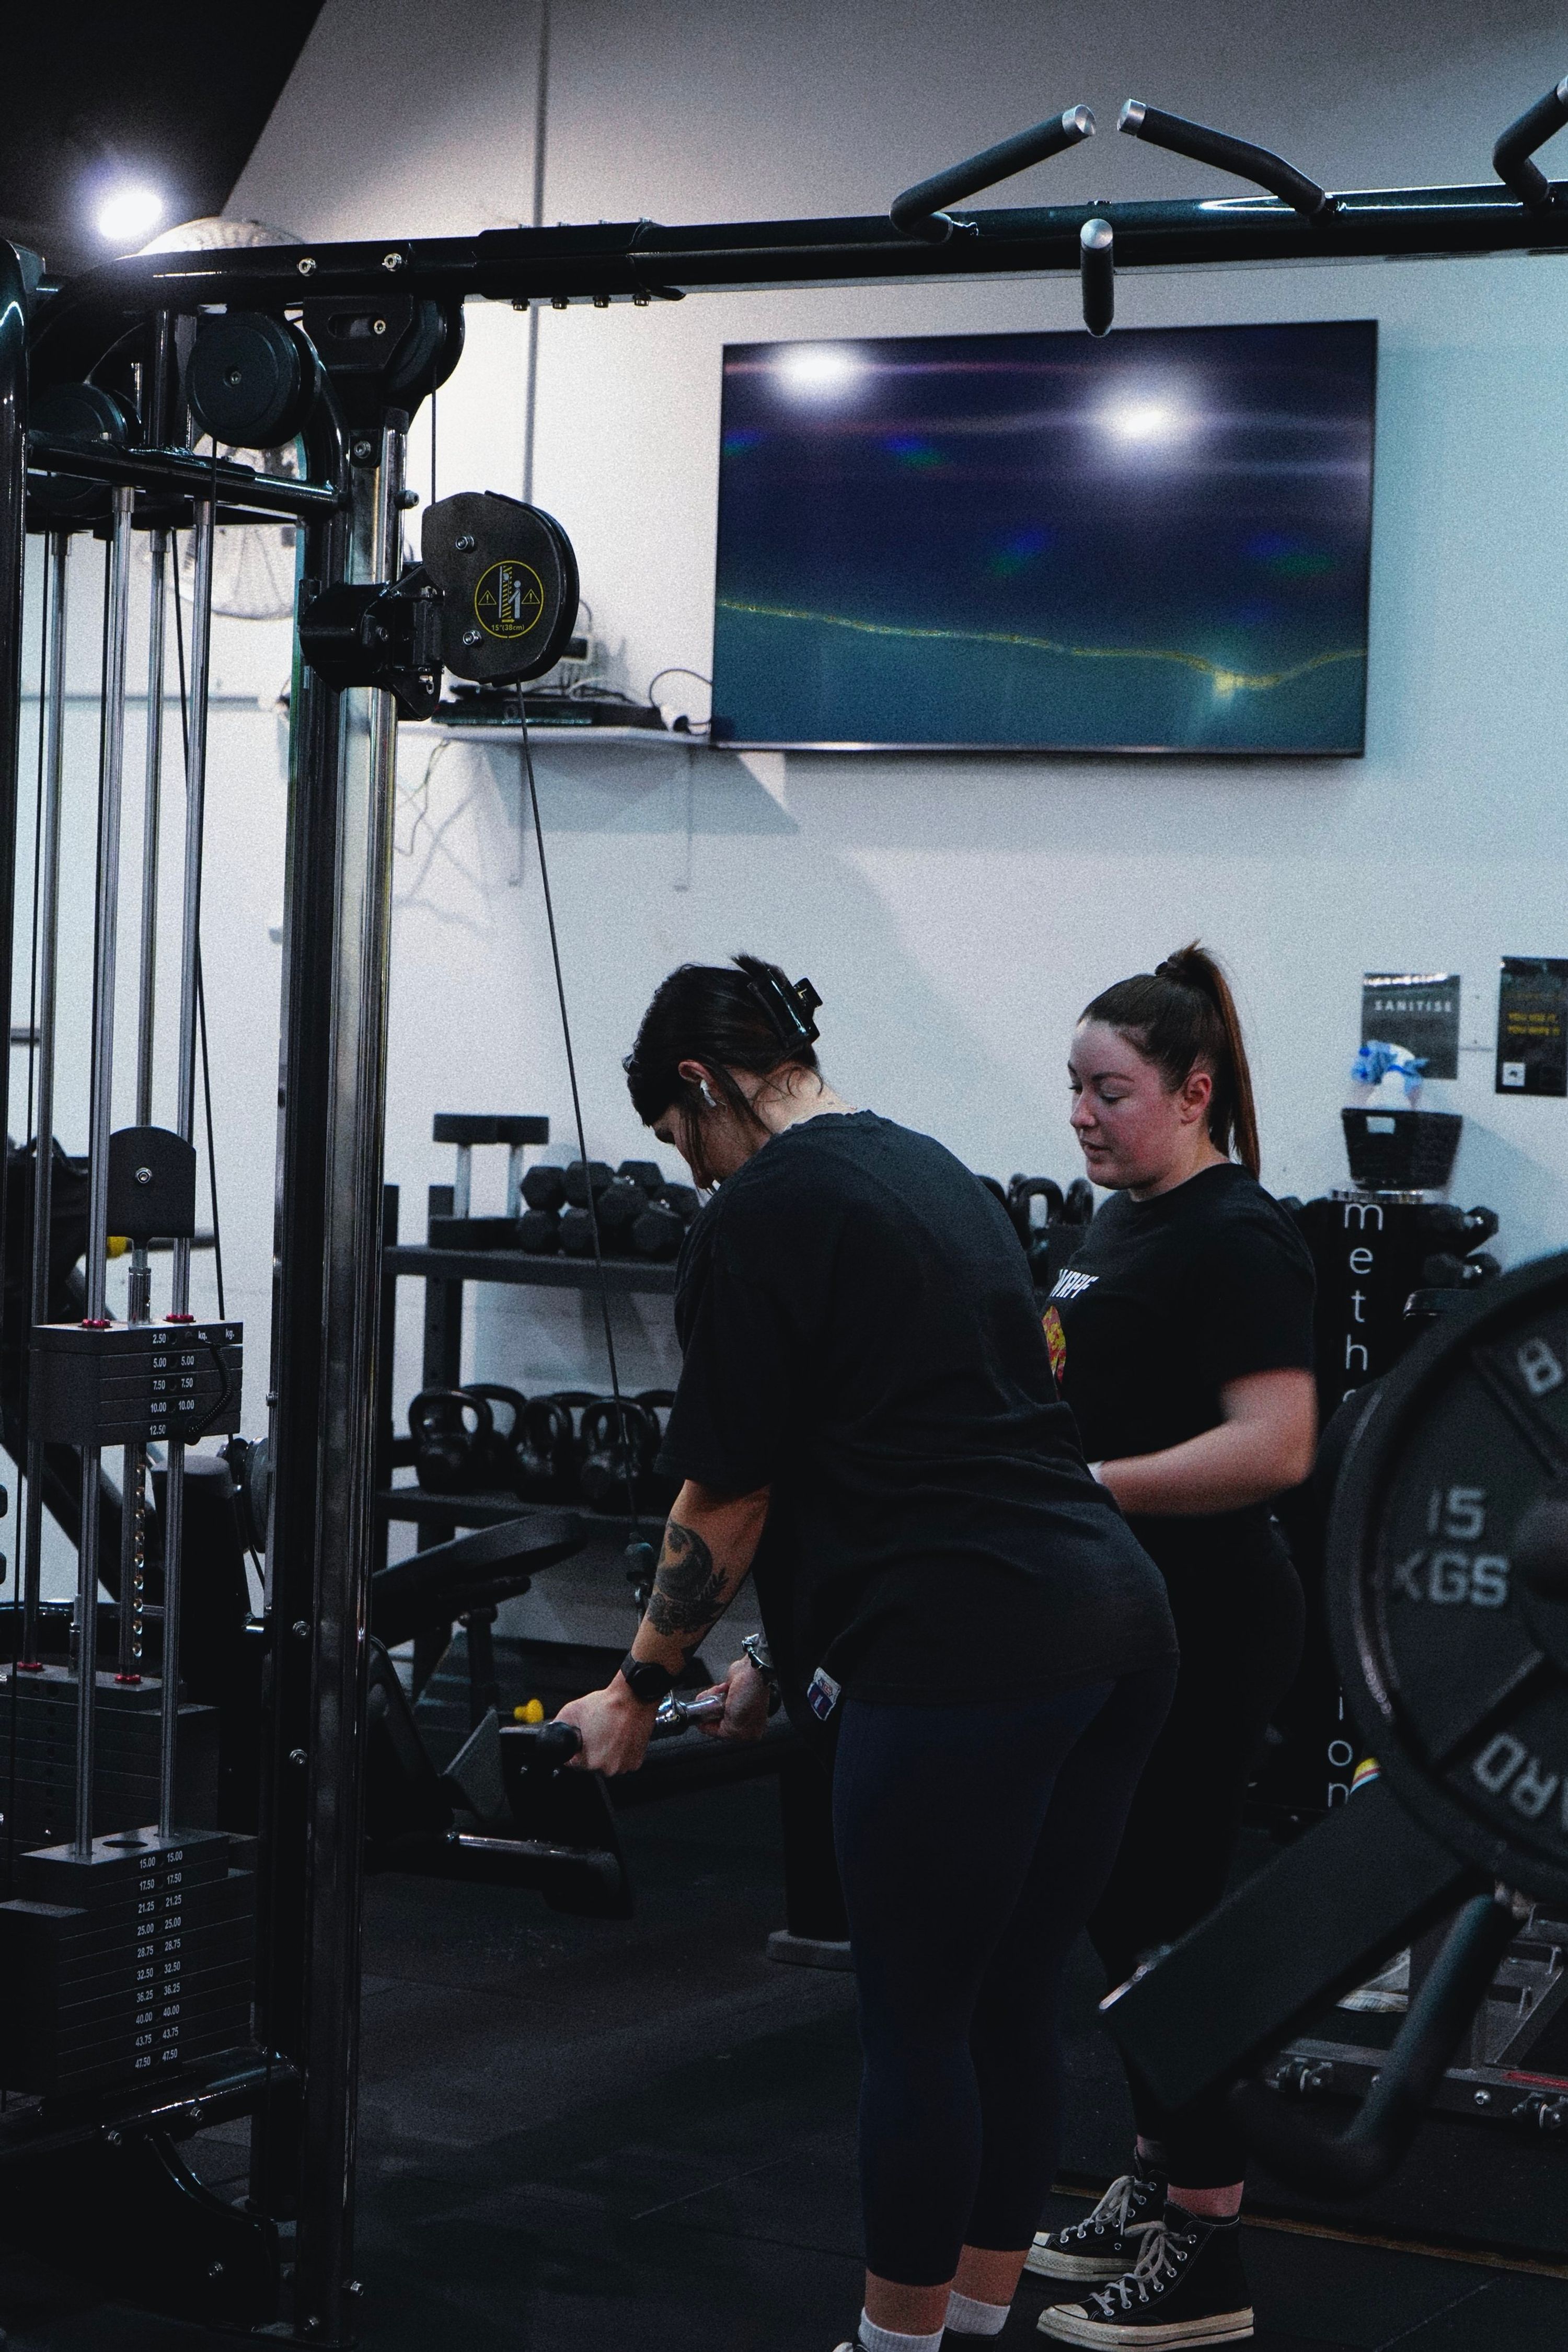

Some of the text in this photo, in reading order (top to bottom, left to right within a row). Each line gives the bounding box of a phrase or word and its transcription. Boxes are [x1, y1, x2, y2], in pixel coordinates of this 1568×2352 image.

[153, 1334, 166, 1343] 2.50
[226, 1329, 234, 1339] kg.
[154, 1356, 194, 1368] 5.00 5.00
[154, 1378, 193, 1390] 7.50 7.50
[151, 1400, 194, 1413] 10.00 10.00
[150, 1425, 165, 1435] 12.50
[1427, 1487, 1485, 1538] 15
[1393, 1549, 1509, 1607] KGS
[140, 1851, 182, 1869] 15.00 15.00
[140, 1873, 181, 1890] 17.50 17.50
[139, 1895, 181, 1913] 21.25 21.25
[137, 1917, 181, 1935] 25.00 25.00
[137, 1939, 180, 1957] 28.75 28.75
[137, 1961, 180, 1980] 32.50 32.50
[137, 1982, 180, 2002] 36.25 36.25
[136, 2004, 179, 2024] 40.00 40.00
[136, 2026, 178, 2046] 43.75 43.75
[135, 2048, 177, 2068] 47.50 47.50
